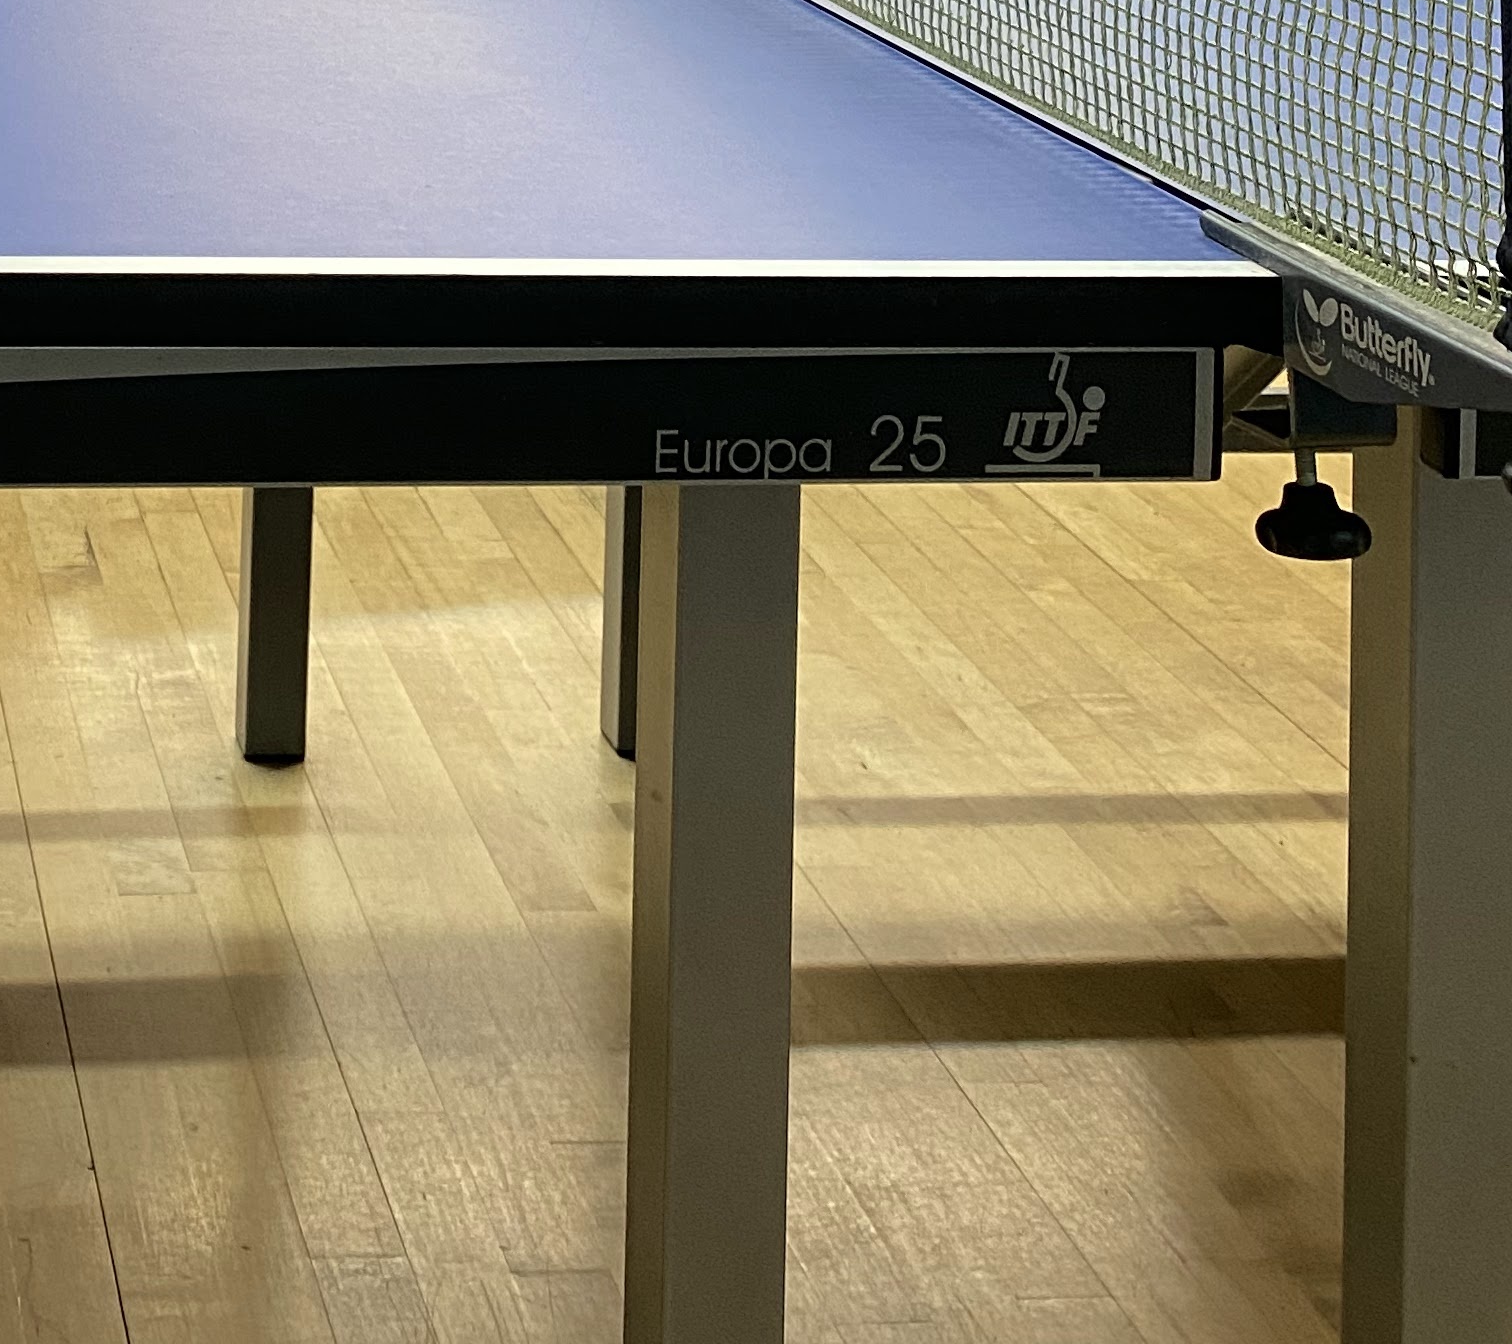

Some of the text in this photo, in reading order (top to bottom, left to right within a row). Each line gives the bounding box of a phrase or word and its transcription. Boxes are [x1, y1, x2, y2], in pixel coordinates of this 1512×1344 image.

[1340, 302, 1432, 387] Butterfly
[1341, 343, 1420, 398] NATIONAL LEAGUE
[655, 415, 947, 480] Europa 25
